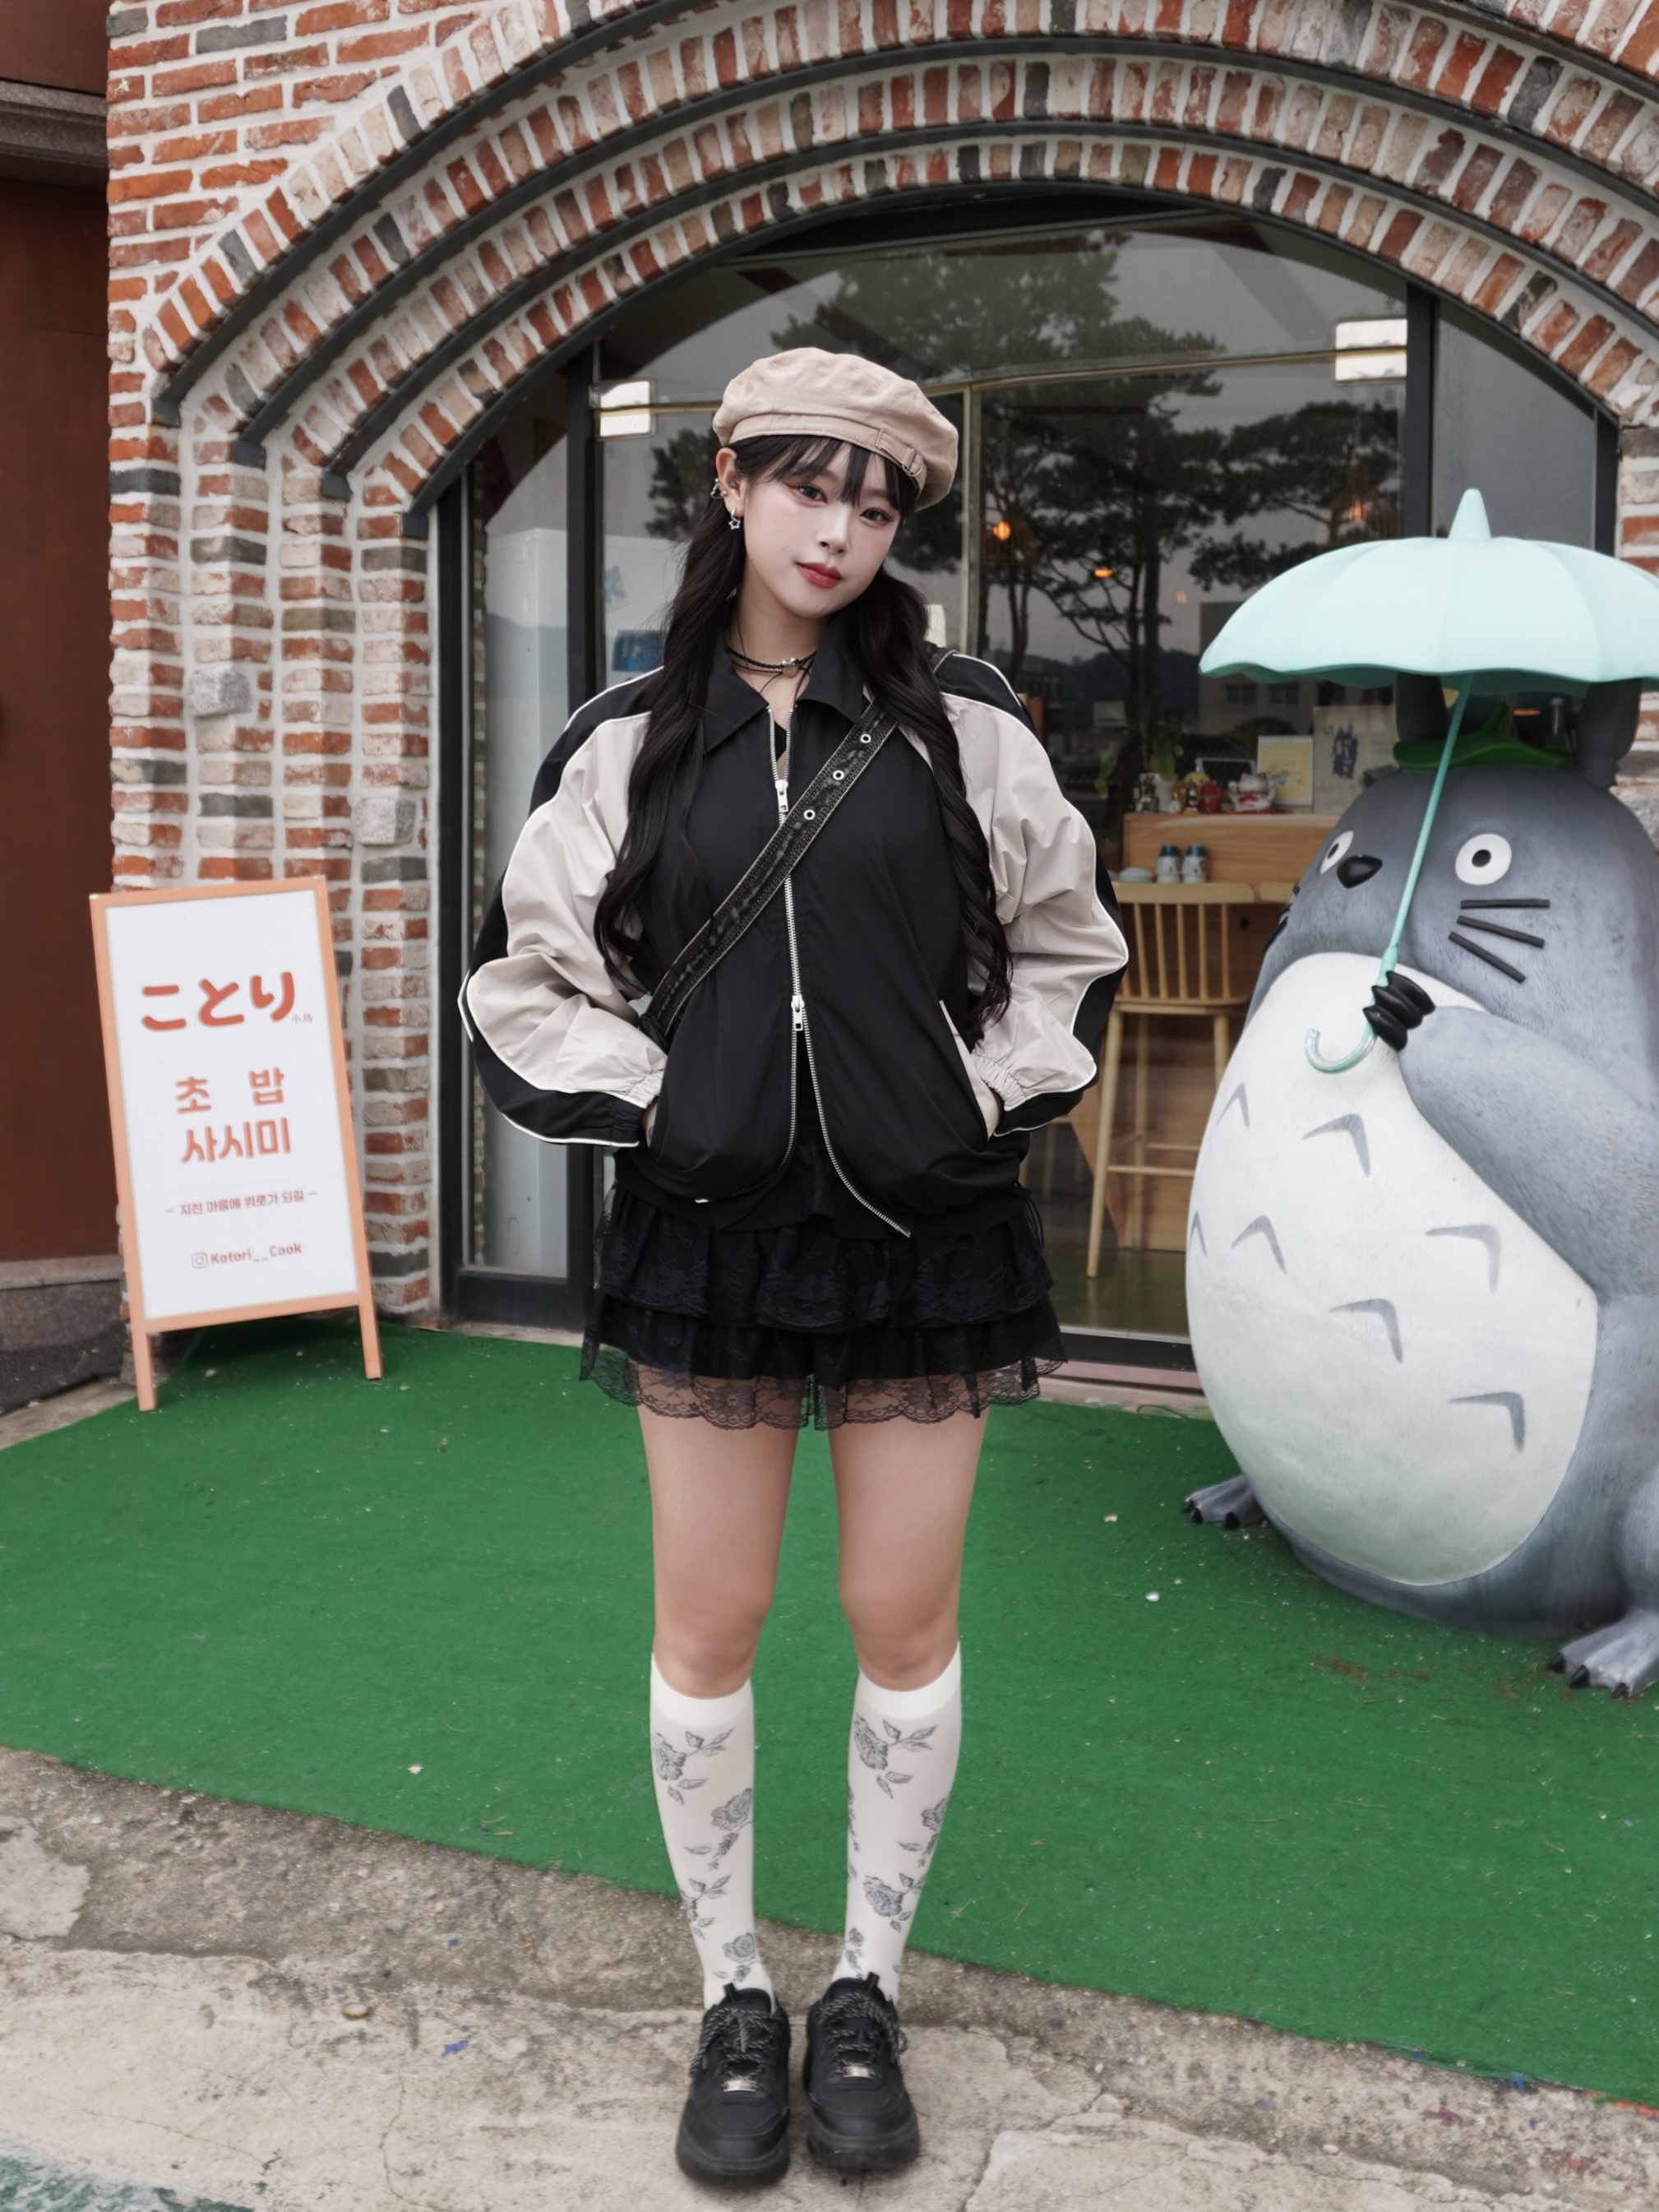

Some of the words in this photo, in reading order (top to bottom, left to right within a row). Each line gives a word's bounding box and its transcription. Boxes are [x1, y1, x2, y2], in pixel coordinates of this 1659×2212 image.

[141, 971, 295, 1031] ことり
[180, 1117, 292, 1164] 사시미
[179, 1201, 204, 1216] 지친
[206, 1197, 241, 1213] 마음에
[243, 1192, 279, 1209] 위로가
[281, 1189, 304, 1203] 되길
